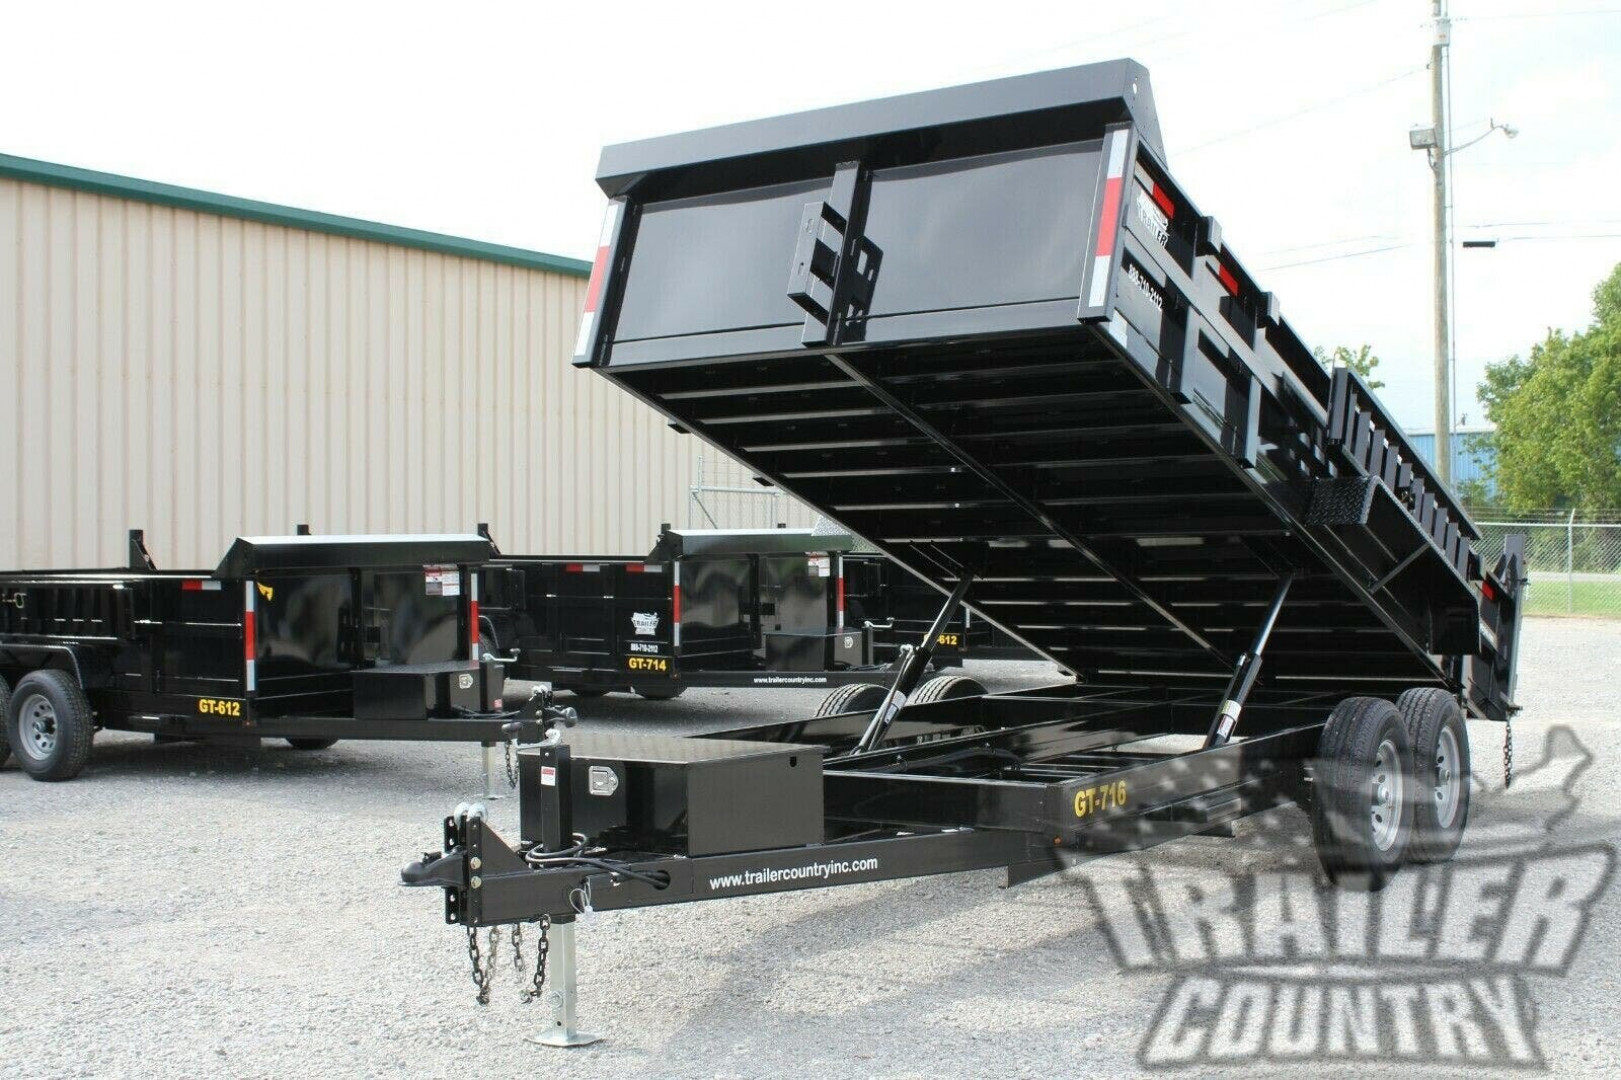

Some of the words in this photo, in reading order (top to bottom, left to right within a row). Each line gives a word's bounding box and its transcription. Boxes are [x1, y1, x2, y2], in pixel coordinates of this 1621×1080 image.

[628, 657, 667, 671] GT-714
[199, 698, 240, 716] GT-612
[1074, 780, 1127, 818] GT-716
[709, 857, 878, 890] www.trailercountryinc.com
